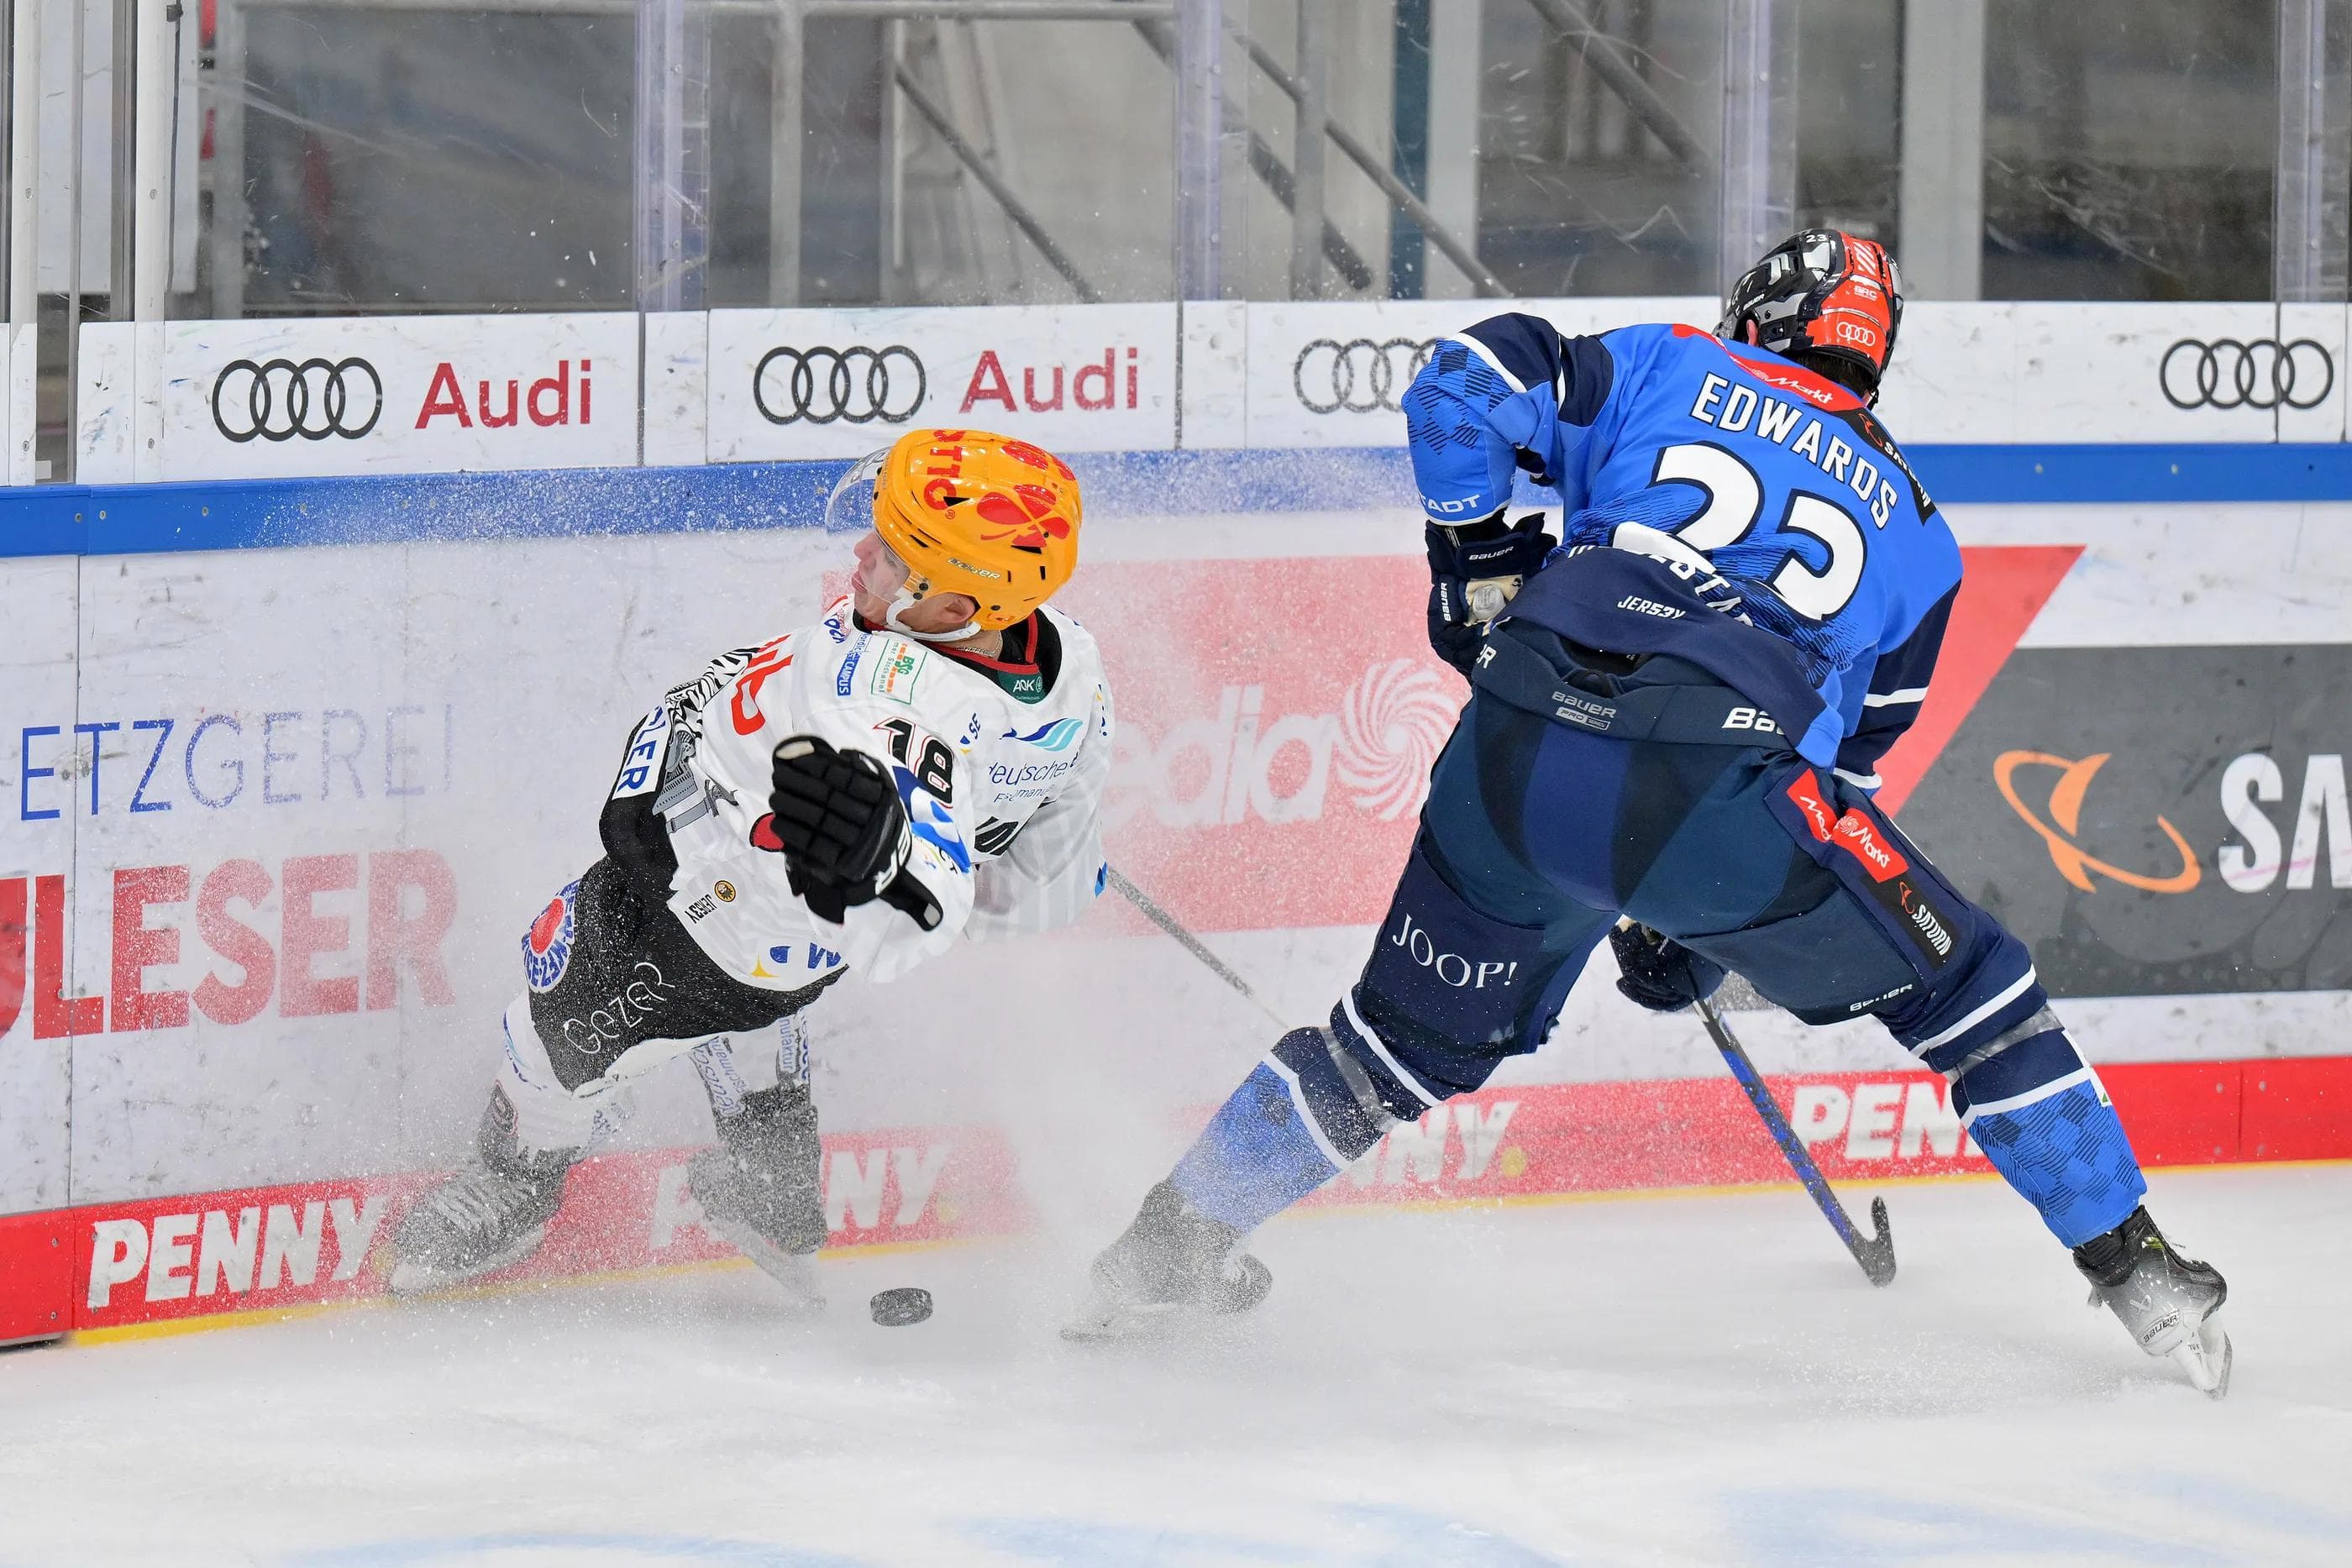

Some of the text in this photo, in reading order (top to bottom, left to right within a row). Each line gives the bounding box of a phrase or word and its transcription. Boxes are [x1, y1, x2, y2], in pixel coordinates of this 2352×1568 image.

[1805, 233, 1829, 243] 23
[415, 359, 591, 429] Audi
[958, 347, 1138, 413] Audi
[1689, 370, 1898, 531] EDWARDS
[1468, 545, 1515, 561] BAUER
[1440, 581, 1452, 622] BAUER
[1551, 690, 1617, 719] BAUER
[20, 704, 454, 821] ETZGEREI
[1850, 827, 1891, 868] Markt
[1392, 913, 1518, 989] JOOP!
[1911, 904, 1952, 956] SATURN
[1790, 1081, 1984, 1160] PEN
[87, 1195, 390, 1309] PENNY
